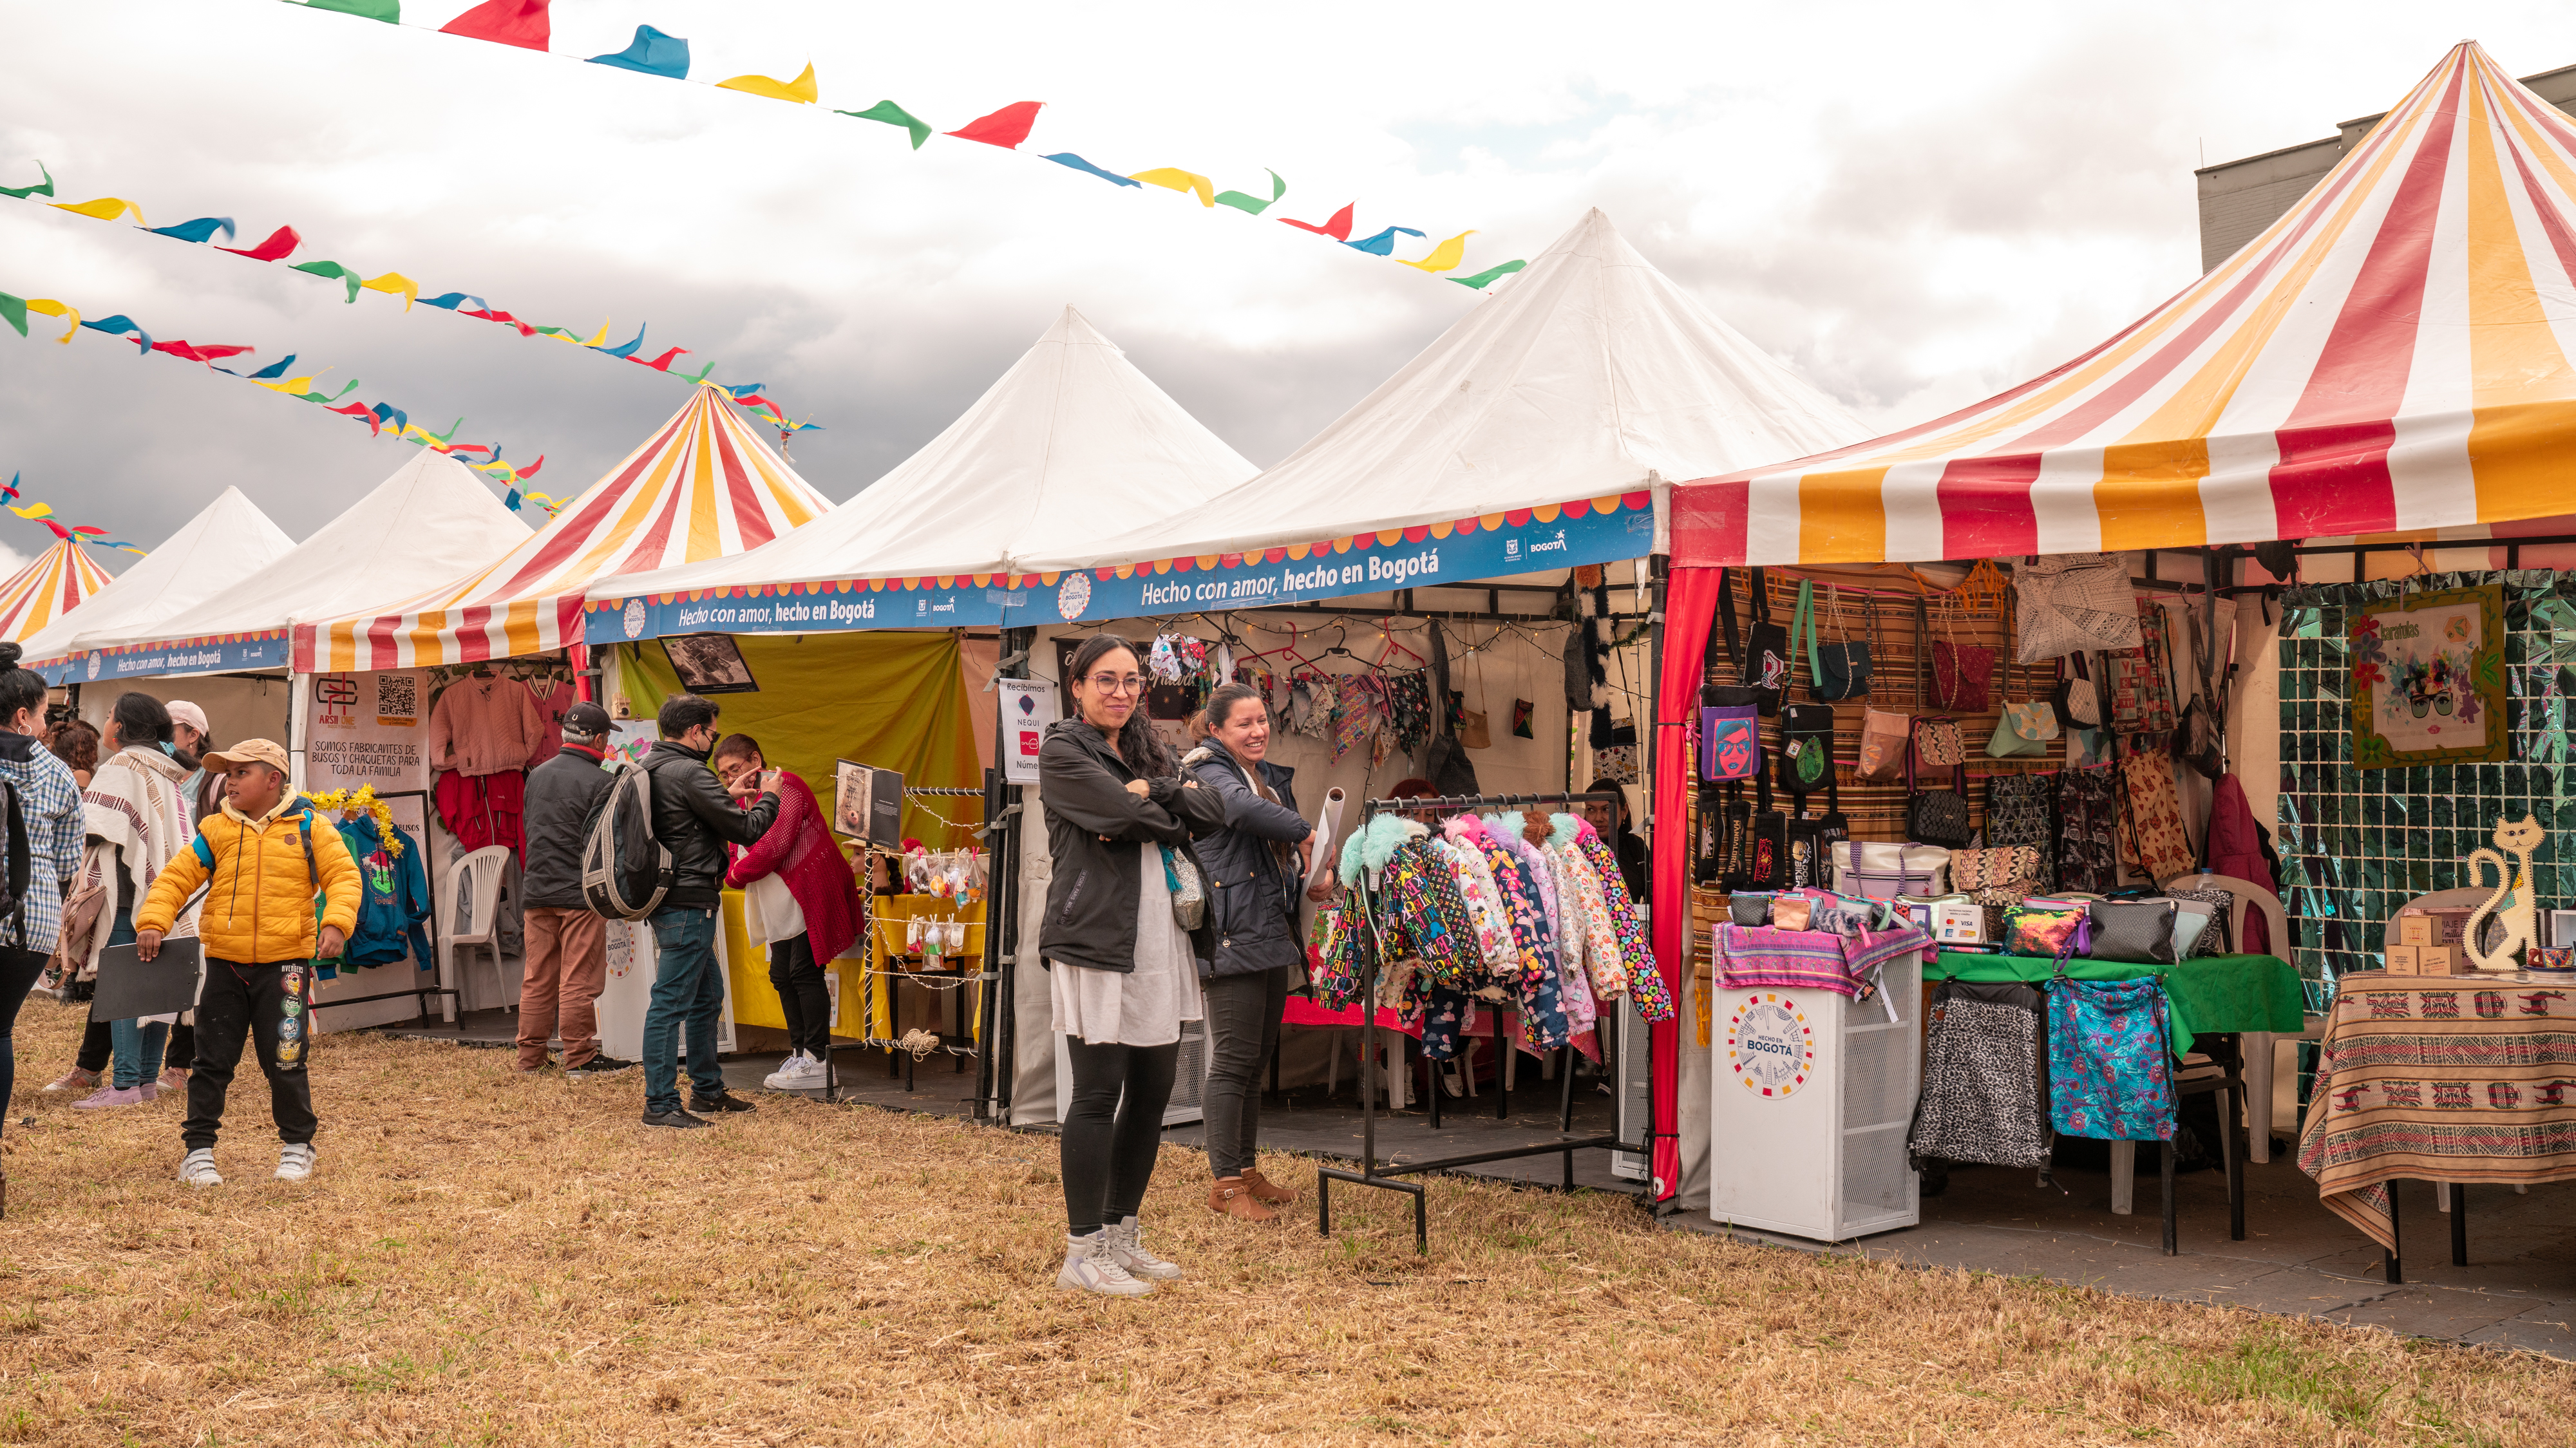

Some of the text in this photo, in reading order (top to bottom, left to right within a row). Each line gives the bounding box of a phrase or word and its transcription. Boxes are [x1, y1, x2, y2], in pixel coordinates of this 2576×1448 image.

[1141, 547, 1439, 606] Hecho con amor, hecho en Bogotá
[678, 599, 875, 627] Hecho con amor, hecho en Bogotá
[2380, 621, 2420, 641] karatulas
[117, 649, 221, 672] Hecho con amor, hecho en Bogotá
[1007, 682, 1045, 693] Recibimos
[341, 715, 355, 726] ONE
[1018, 719, 1039, 727] NEQUI
[315, 740, 417, 755] SOMOS FABRICANTES DE
[312, 752, 420, 766] BUSOS Y CHAQUETAS PARA
[1016, 760, 1039, 769] Núme
[331, 764, 401, 777] TODA LA FAMILIA
[399, 823, 420, 832] BUSOS
[1727, 820, 1739, 873] MANDALORIAN
[1794, 861, 1803, 888] BIKER
[1077, 876, 1085, 887] YORK
[1070, 888, 1080, 901] PARIS
[1063, 901, 1073, 915] MILAN
[2445, 929, 2463, 938] millas
[607, 940, 627, 951] BOGOTÁ
[281, 965, 303, 973] AVENGERS
[1747, 1039, 1793, 1057] BOGOTÁ
